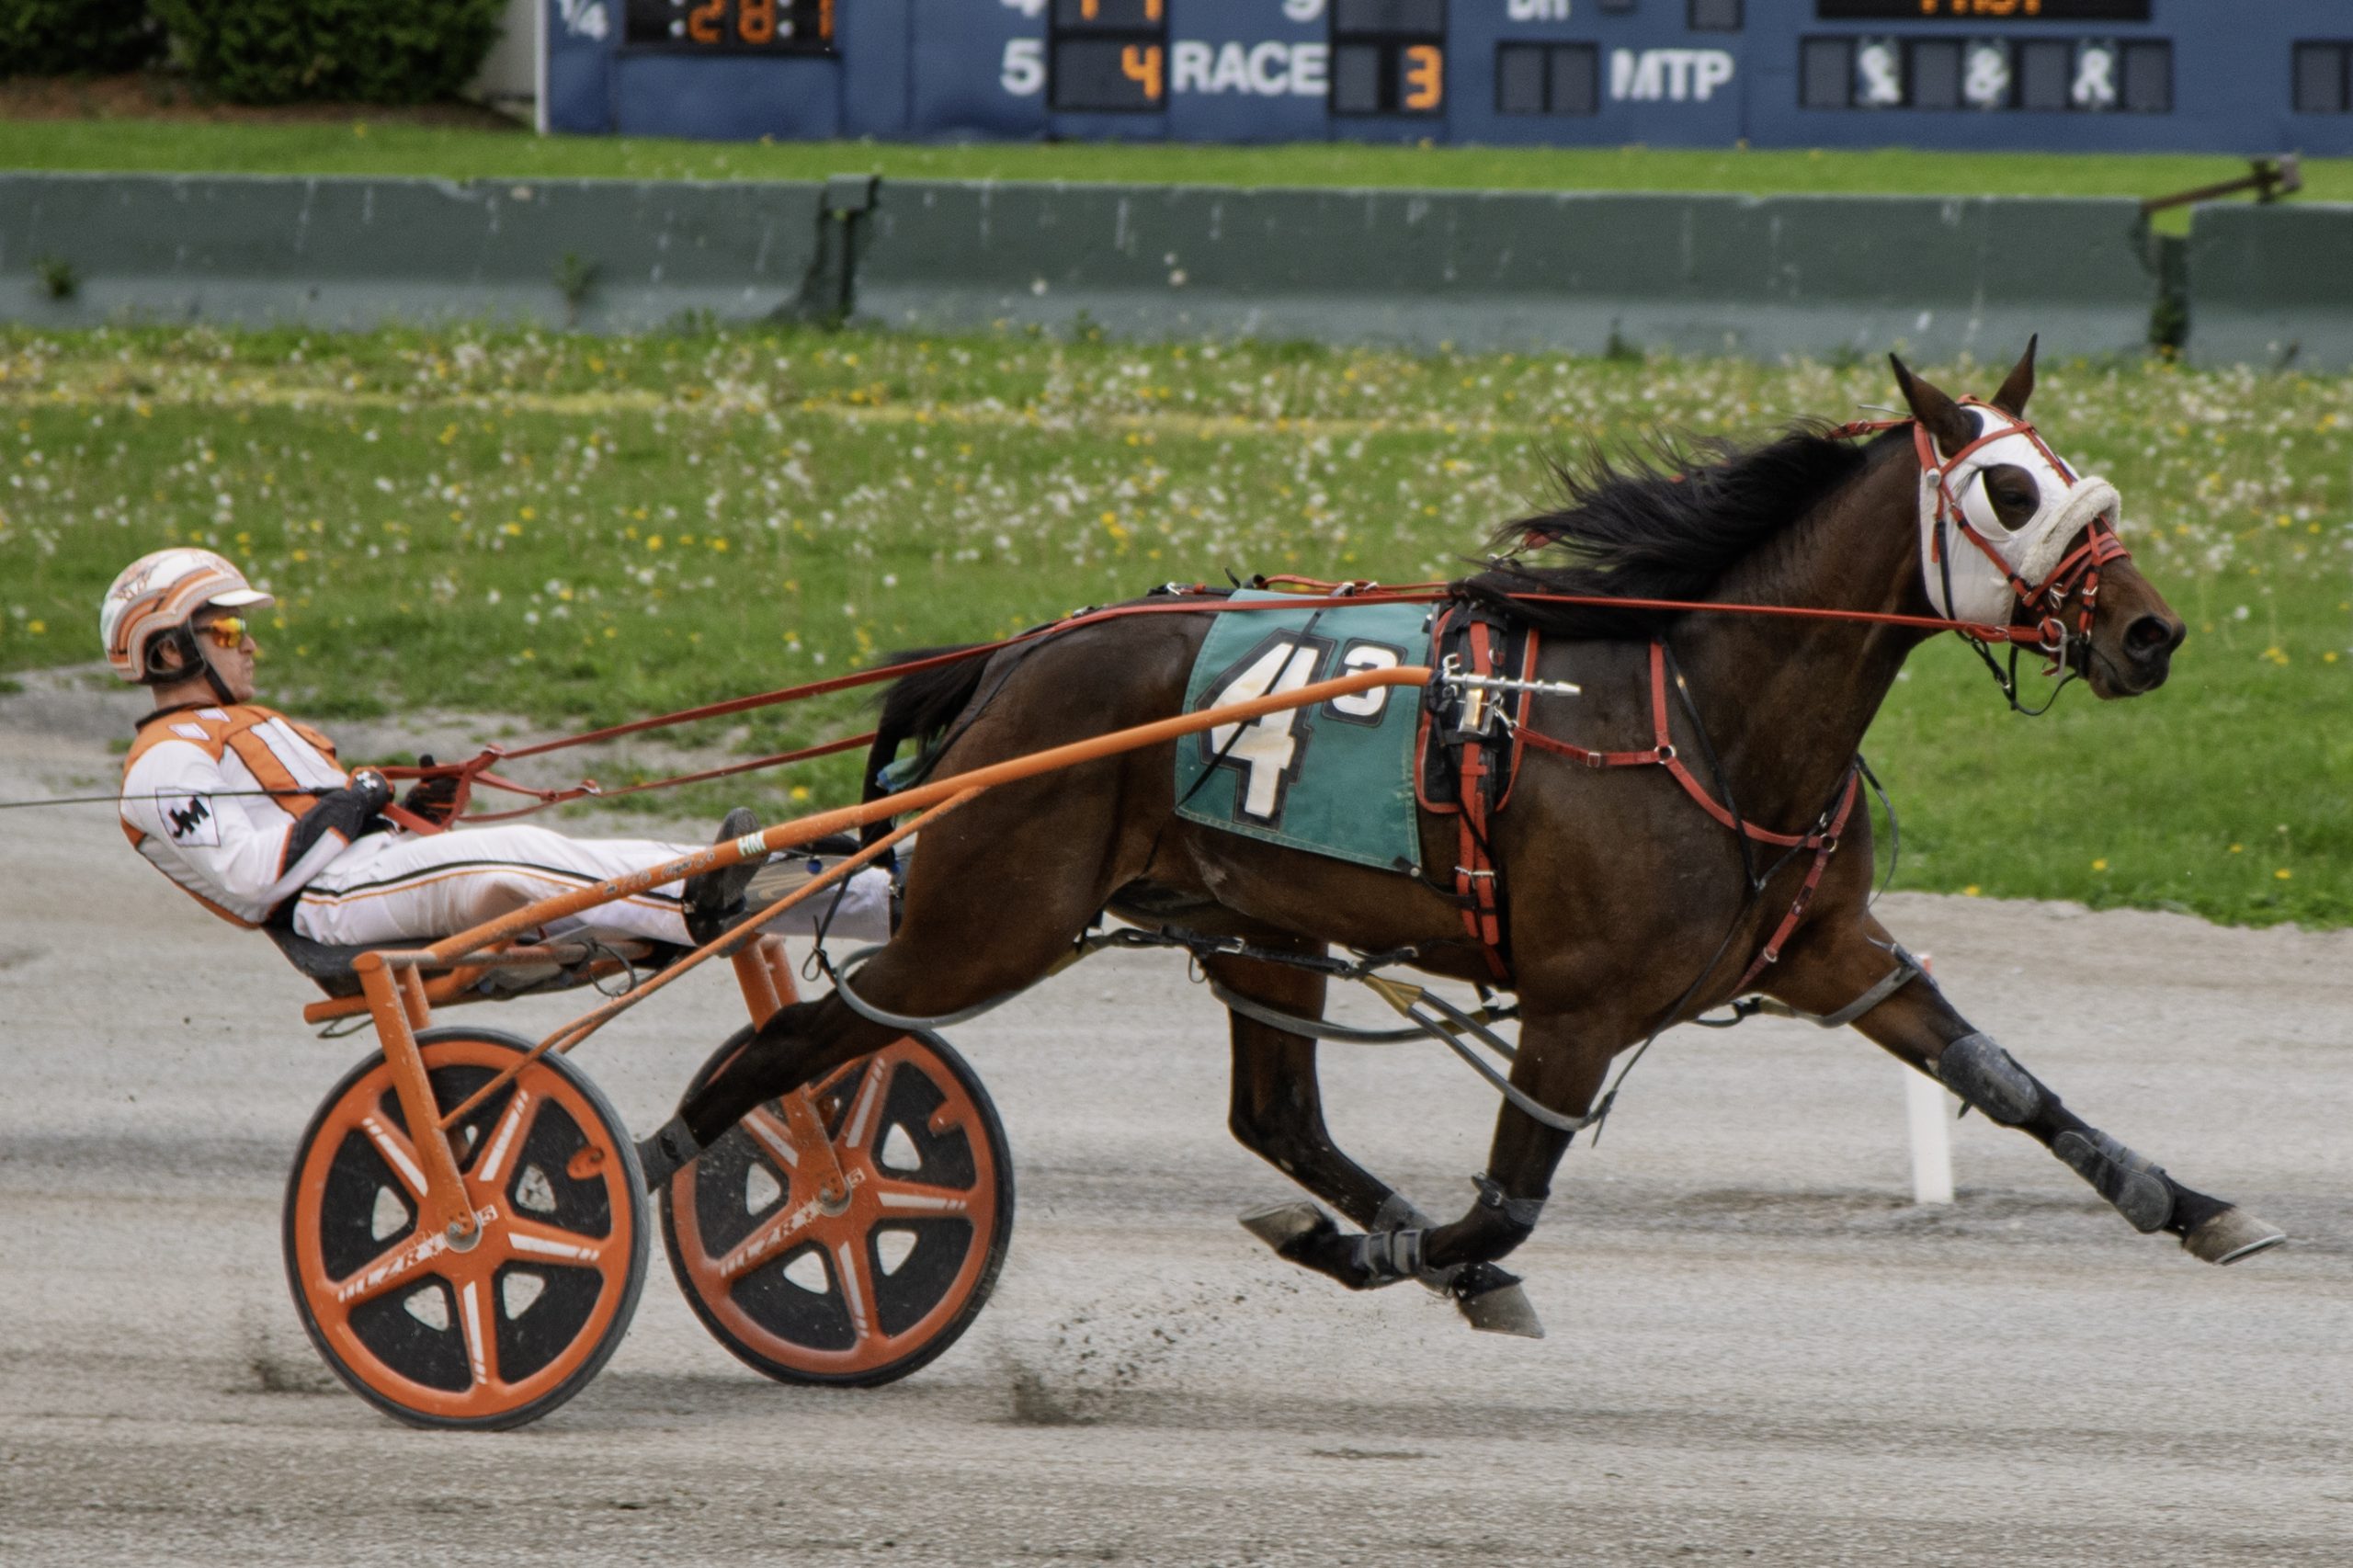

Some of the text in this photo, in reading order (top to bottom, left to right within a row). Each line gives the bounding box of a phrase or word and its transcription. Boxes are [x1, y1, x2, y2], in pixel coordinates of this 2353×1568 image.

[1001, 39, 1046, 96] 5
[1121, 46, 1163, 100] 4
[1171, 41, 1329, 96] RACE
[1405, 45, 1442, 109] 3
[1611, 48, 1733, 101] MTP
[1211, 642, 1320, 818] 4
